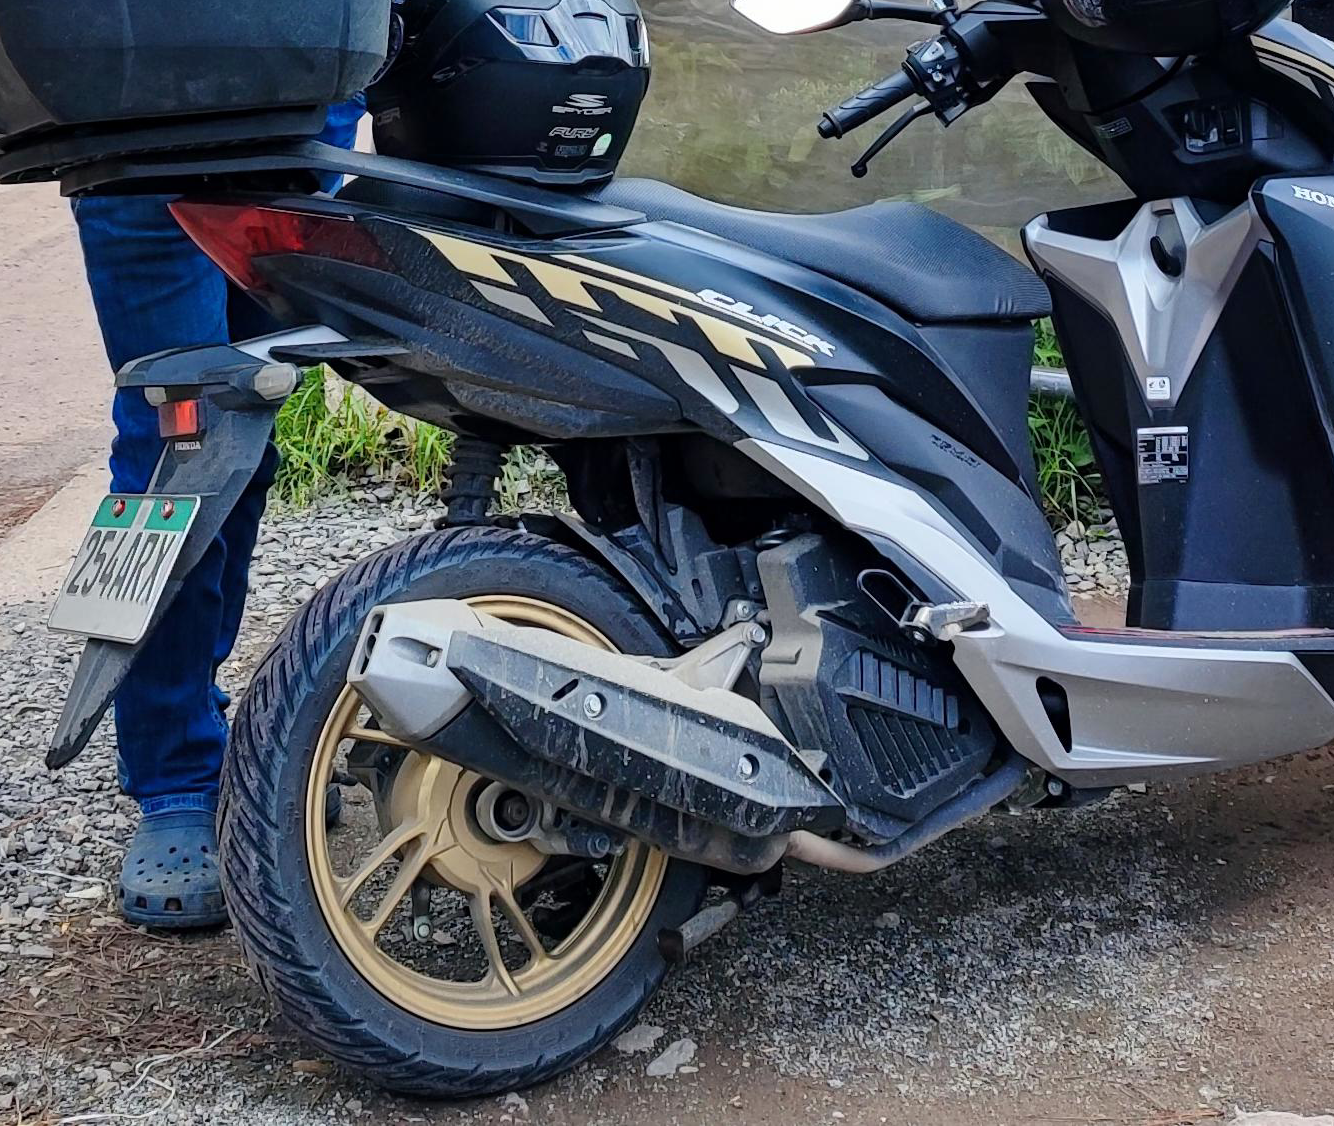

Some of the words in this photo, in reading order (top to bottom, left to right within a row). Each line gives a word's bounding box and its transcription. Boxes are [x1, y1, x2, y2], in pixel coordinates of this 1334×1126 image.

[552, 105, 613, 115] SPYDER
[548, 126, 600, 139] FURY
[696, 288, 836, 358] CLICK
[174, 440, 202, 451] HONDA
[66, 529, 178, 603] 254ARX
